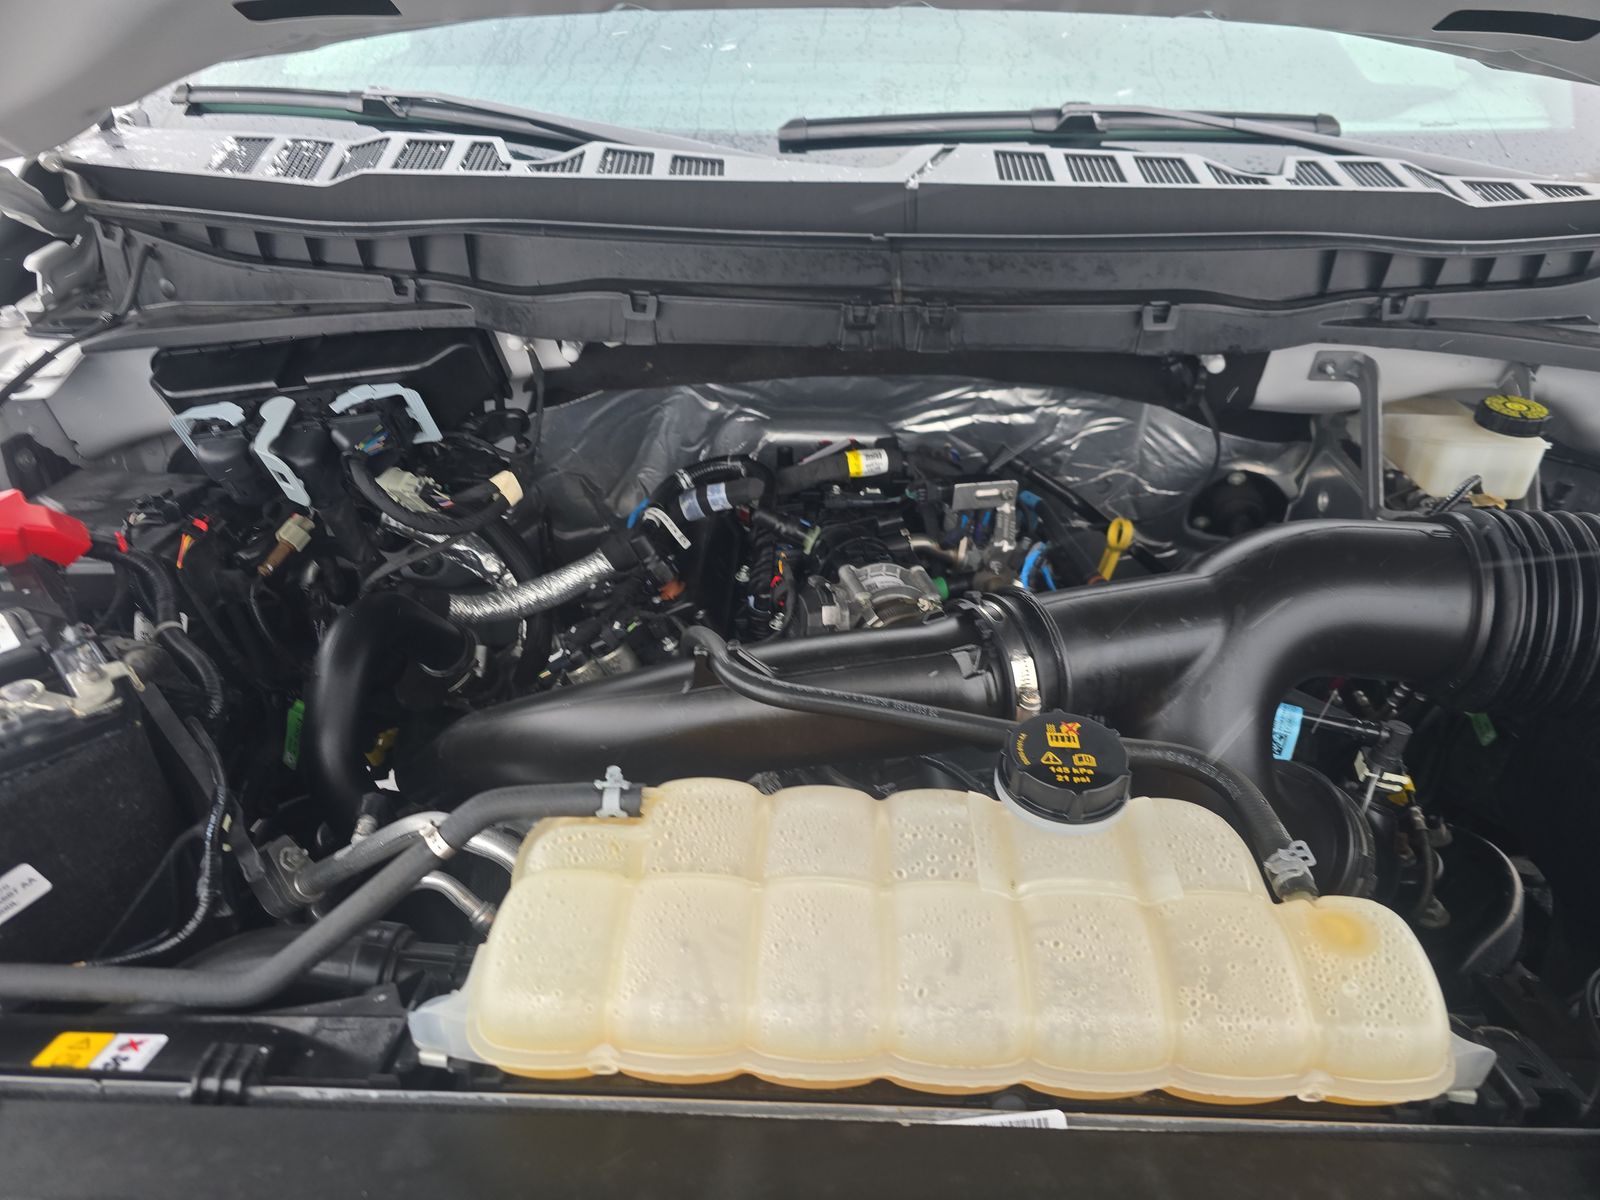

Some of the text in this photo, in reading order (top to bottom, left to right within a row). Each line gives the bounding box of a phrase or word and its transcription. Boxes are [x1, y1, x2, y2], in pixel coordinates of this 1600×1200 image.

[1049, 766, 1095, 775] 145 kPa
[1056, 774, 1091, 784] 21 psi
